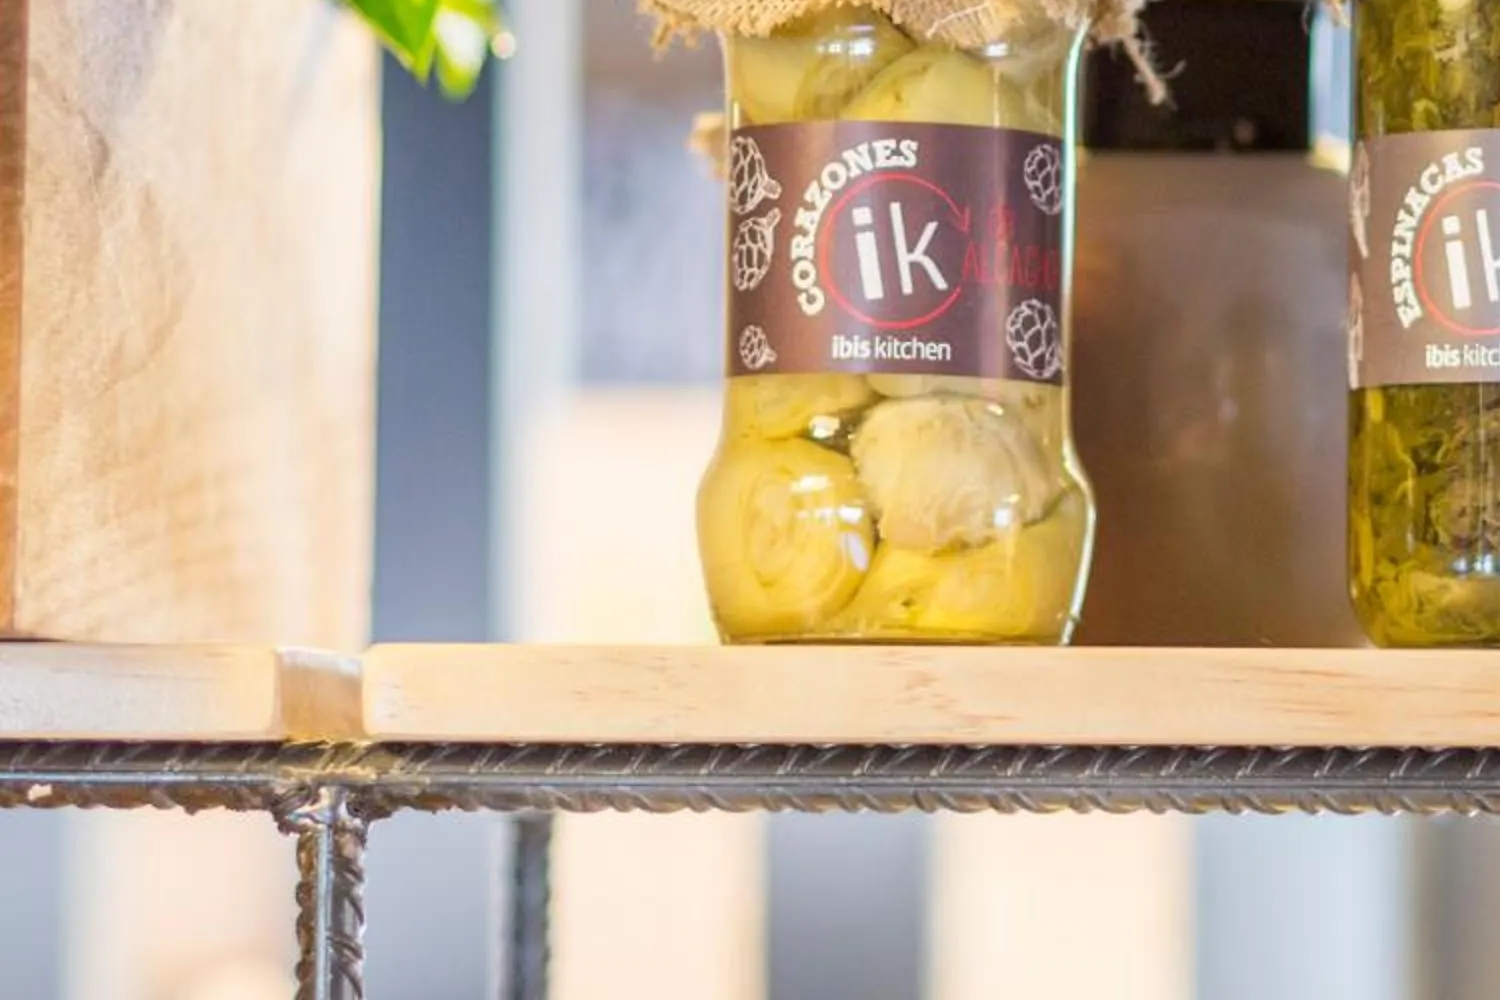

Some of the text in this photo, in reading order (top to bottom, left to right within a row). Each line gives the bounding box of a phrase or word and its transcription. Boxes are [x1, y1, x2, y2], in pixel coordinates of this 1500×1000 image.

[790, 138, 919, 316] CORAZONES
[852, 202, 949, 300] ik
[1390, 146, 1485, 329] ESPINACAS
[831, 335, 951, 361] ibis kitchen
[1425, 343, 1461, 369] ibis
